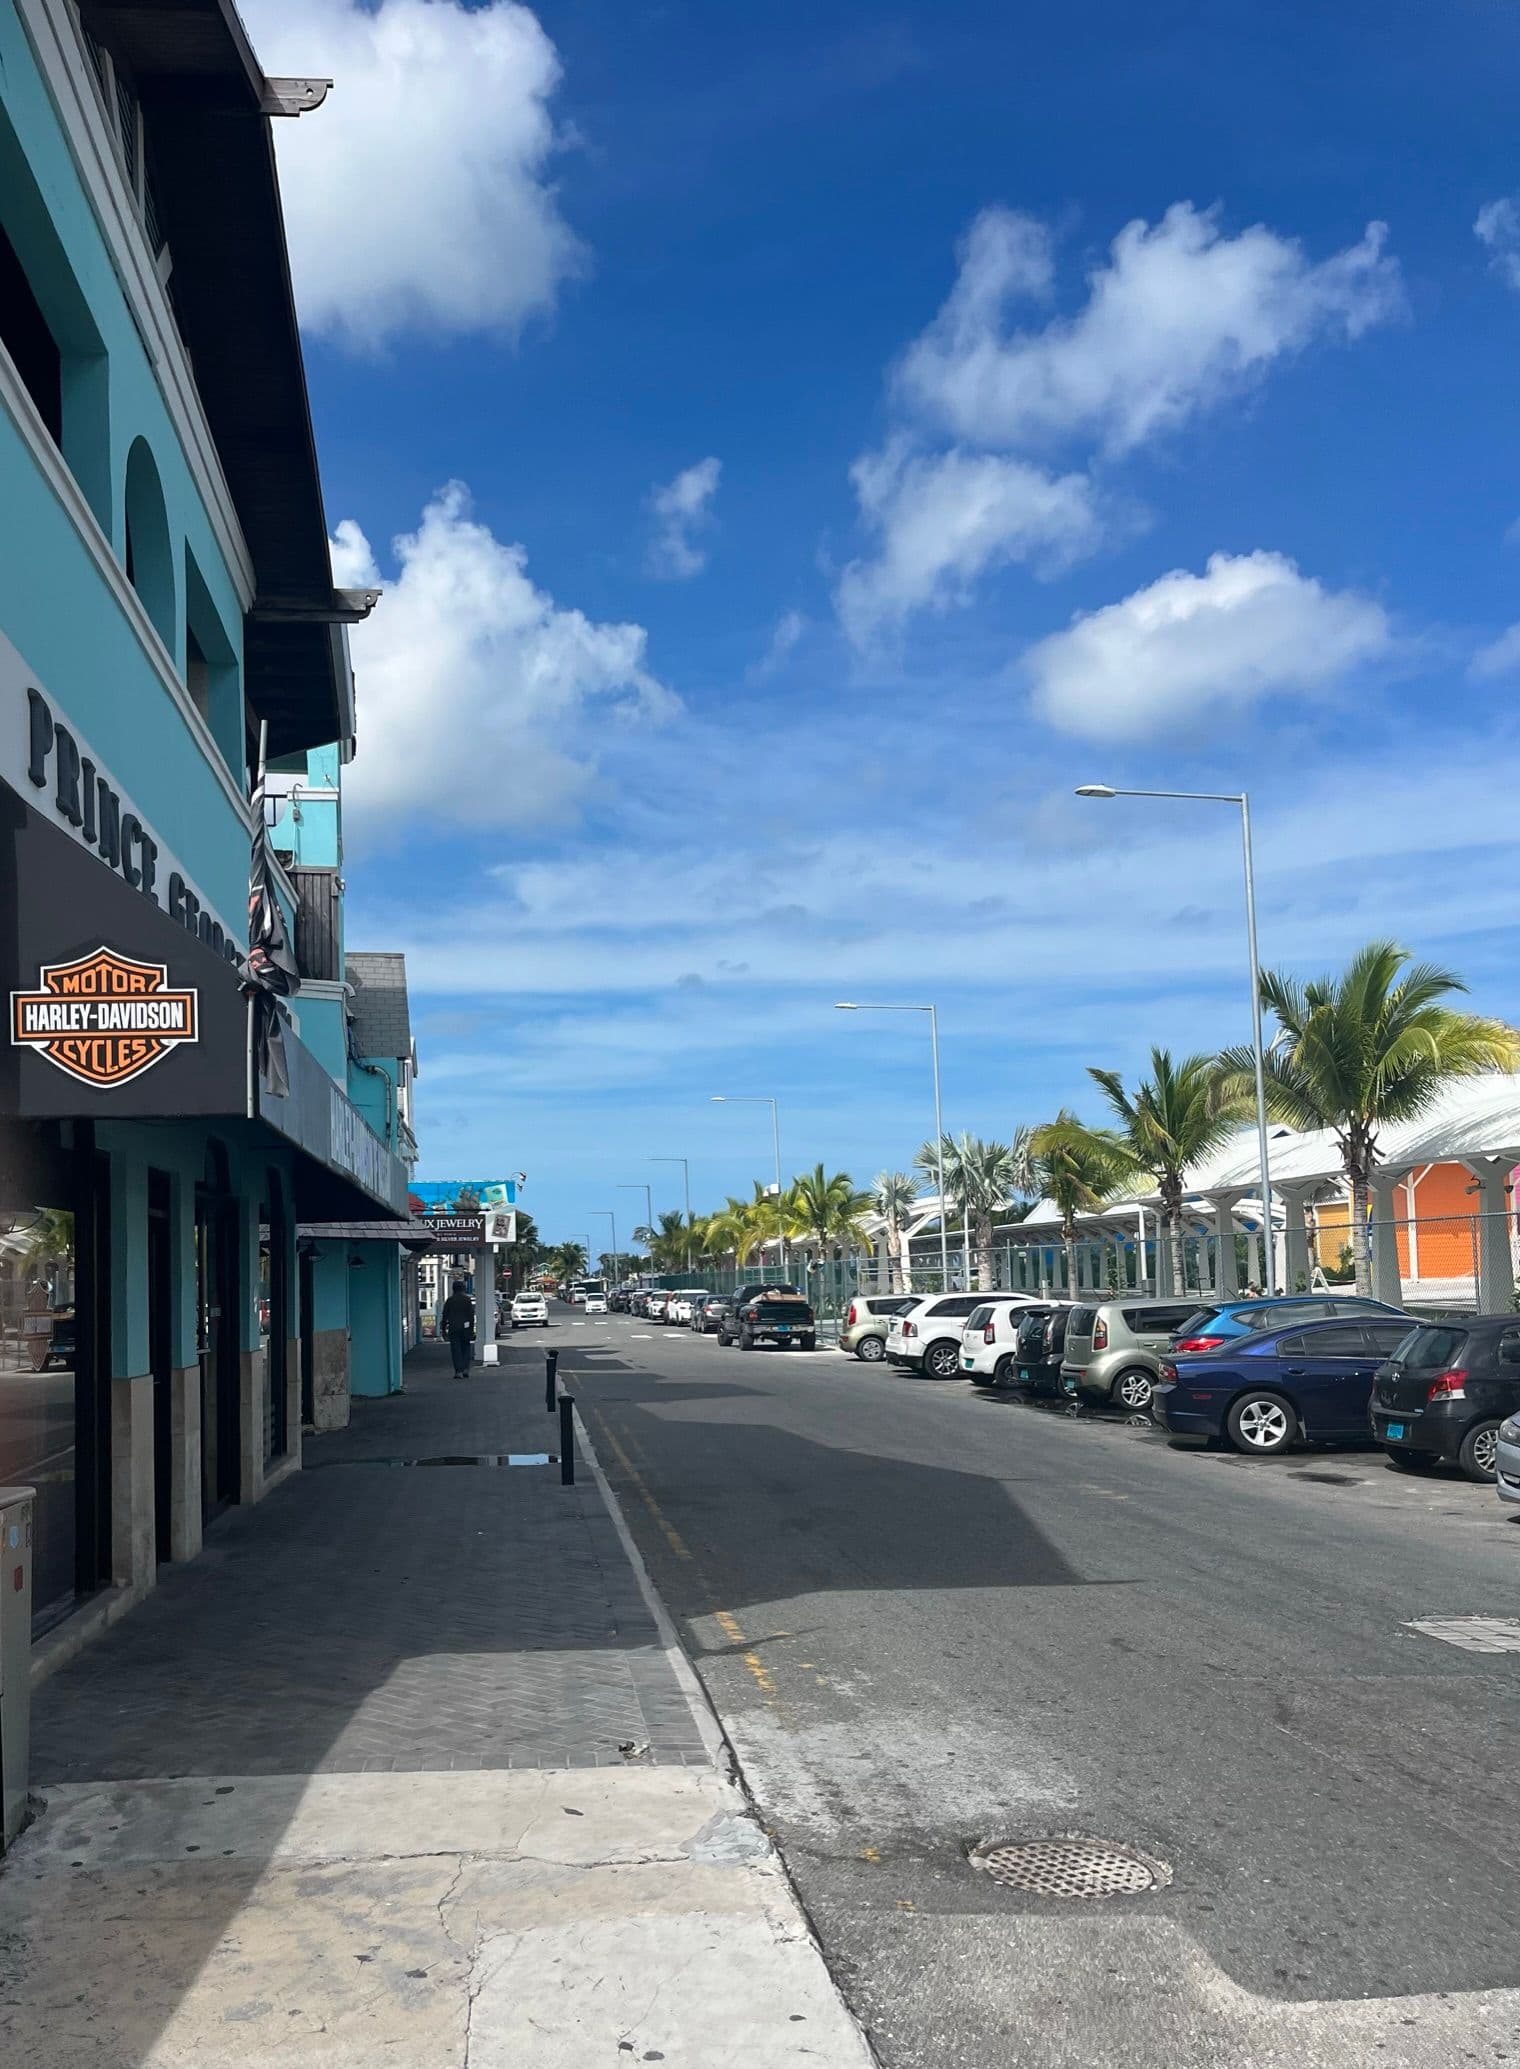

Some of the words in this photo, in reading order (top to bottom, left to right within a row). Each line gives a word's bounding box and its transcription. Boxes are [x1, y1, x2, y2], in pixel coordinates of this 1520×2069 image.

[27, 687, 160, 907] PRINCE
[62, 963, 146, 994] MOTOR
[25, 1001, 184, 1032] HARLEY-DAVIDSON
[62, 1039, 147, 1074] CYCLES
[435, 1218, 484, 1230] JEWELRY
